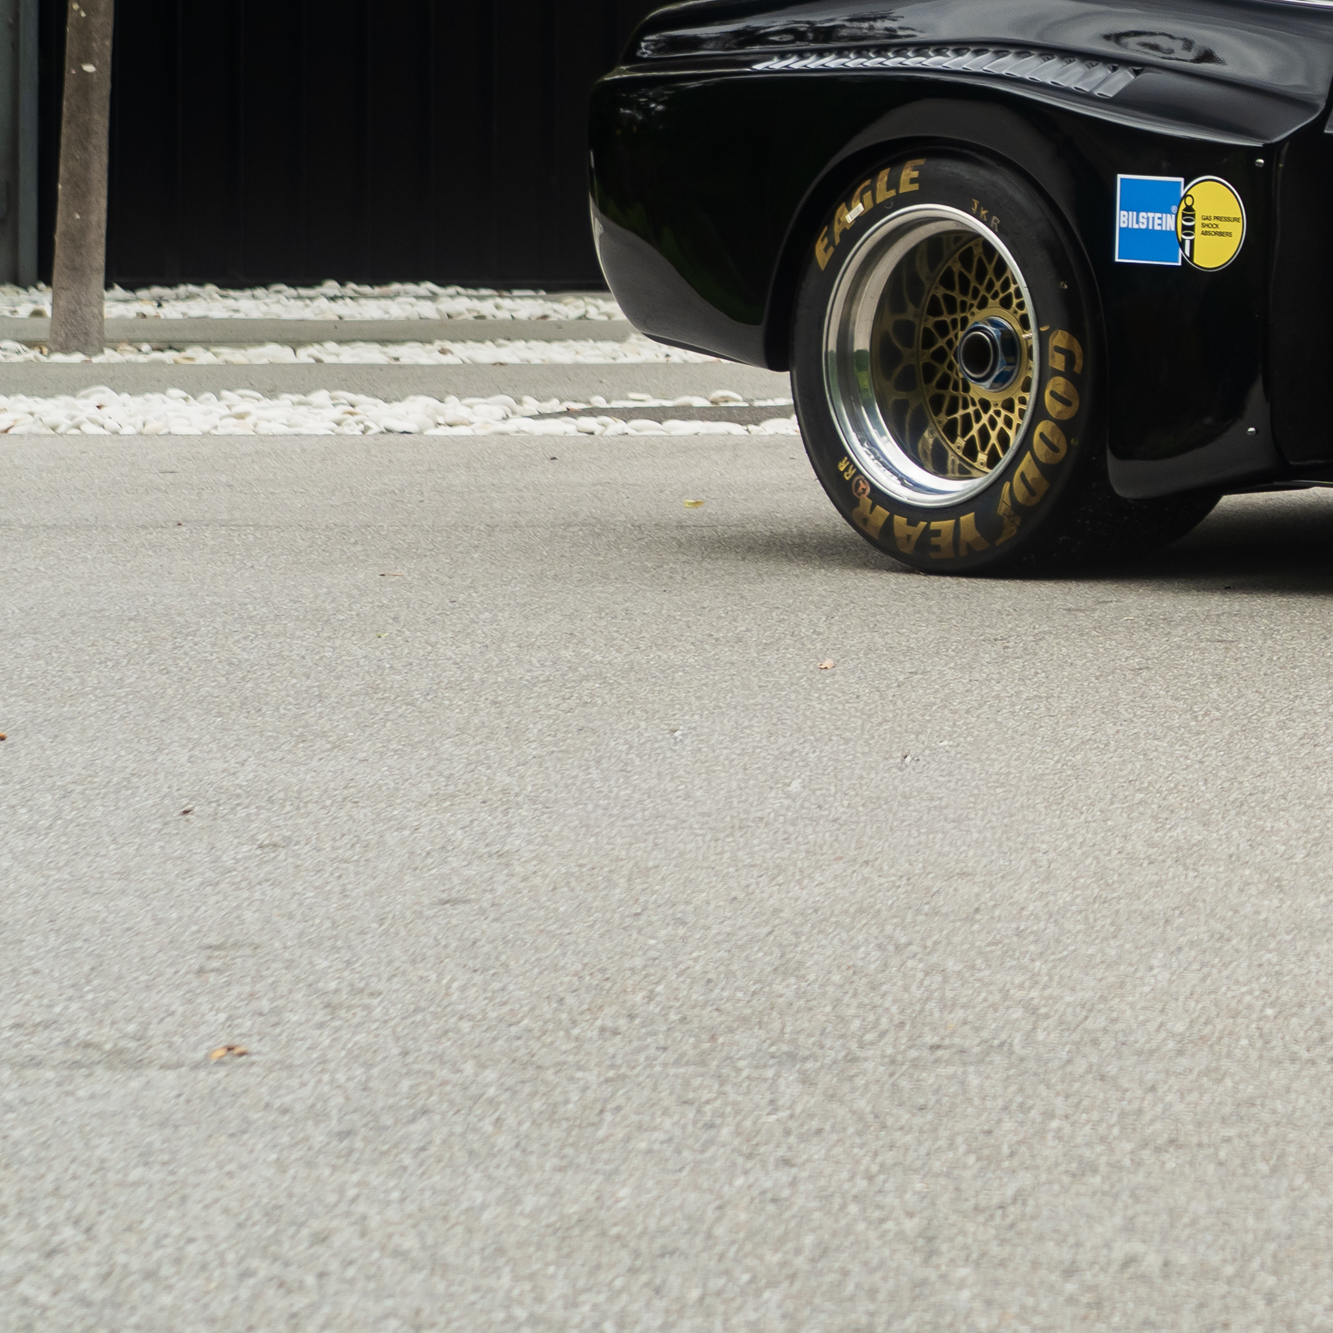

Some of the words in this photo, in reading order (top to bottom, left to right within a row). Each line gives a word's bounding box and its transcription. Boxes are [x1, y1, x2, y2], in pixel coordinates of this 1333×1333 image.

[814, 158, 928, 272] EAGLE
[1119, 210, 1176, 231] BILSTEIN
[1213, 215, 1241, 224] PRESSURE
[1200, 230, 1233, 238] ABSORBERS
